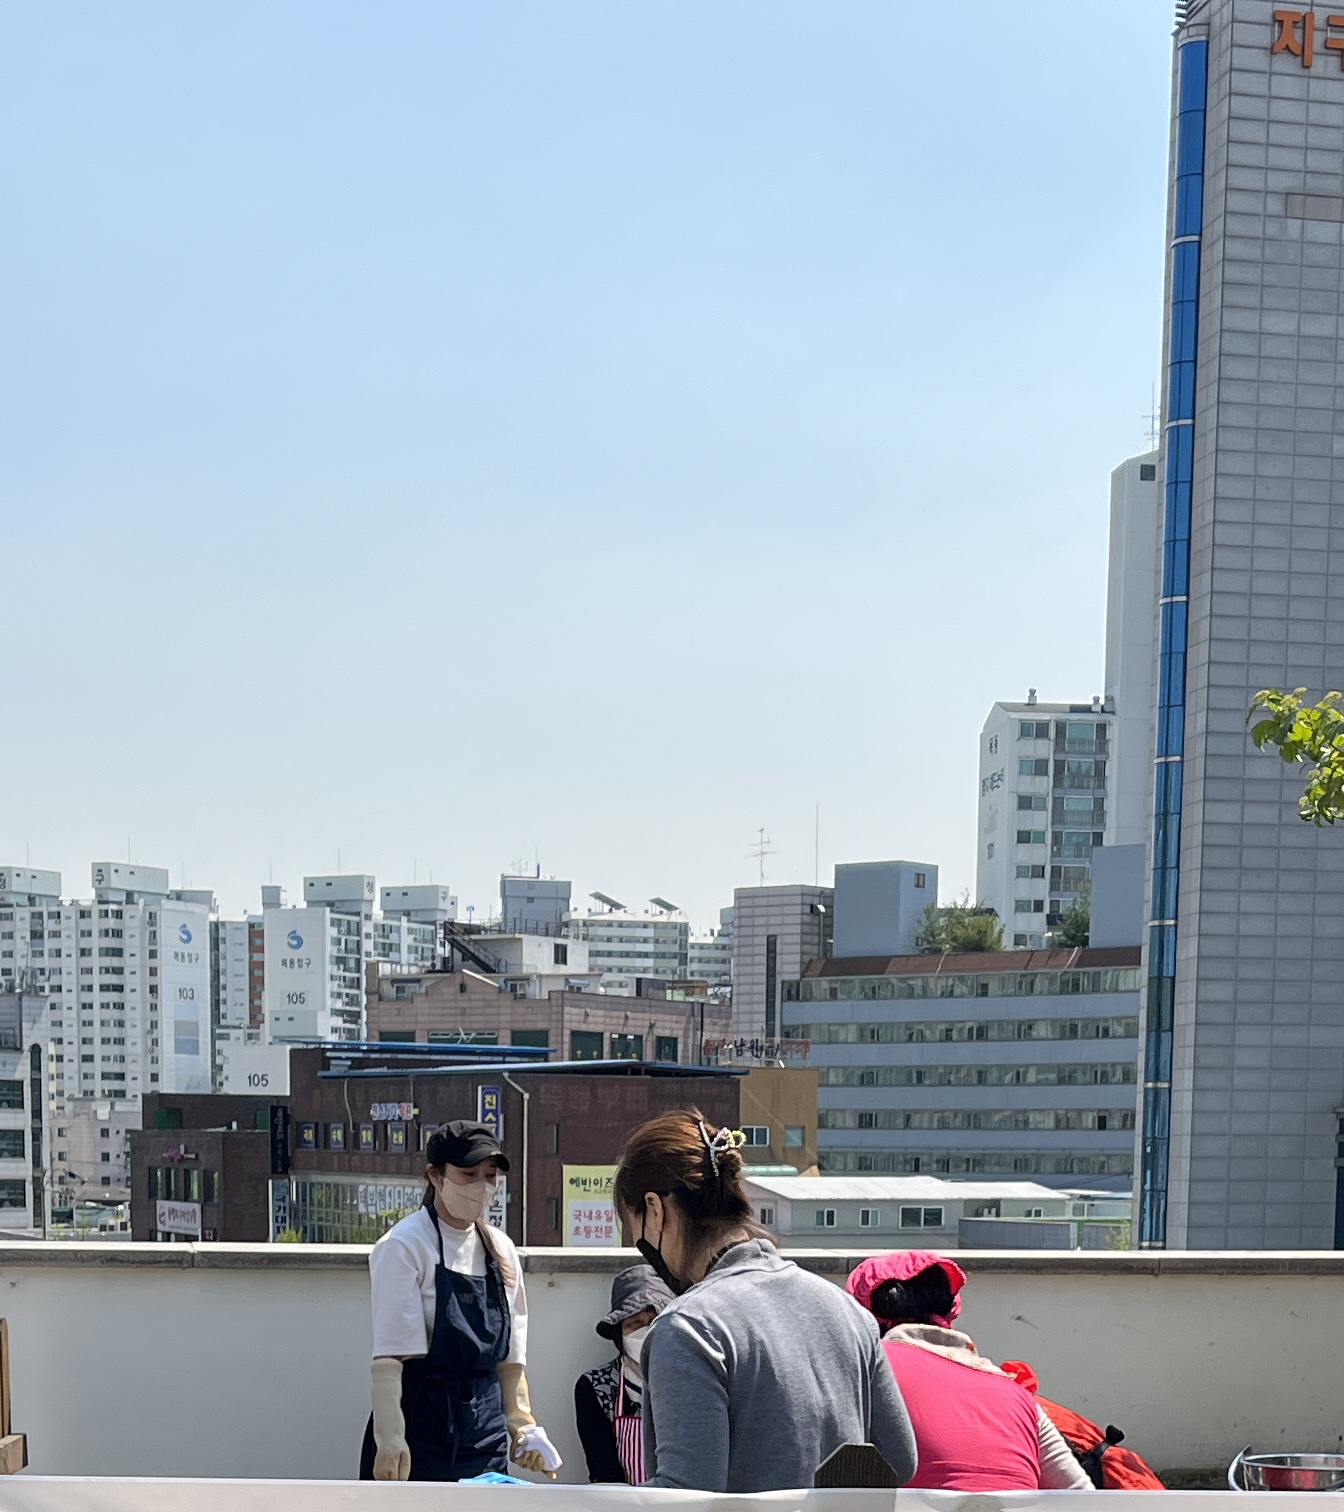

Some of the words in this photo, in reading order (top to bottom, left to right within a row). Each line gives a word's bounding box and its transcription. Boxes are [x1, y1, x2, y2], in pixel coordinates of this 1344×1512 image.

[178, 987, 195, 1000] 103
[286, 992, 306, 1005] 105
[247, 1074, 269, 1087] 105
[572, 1209, 614, 1222] 국내유일
[572, 1225, 614, 1239] 초등전문
